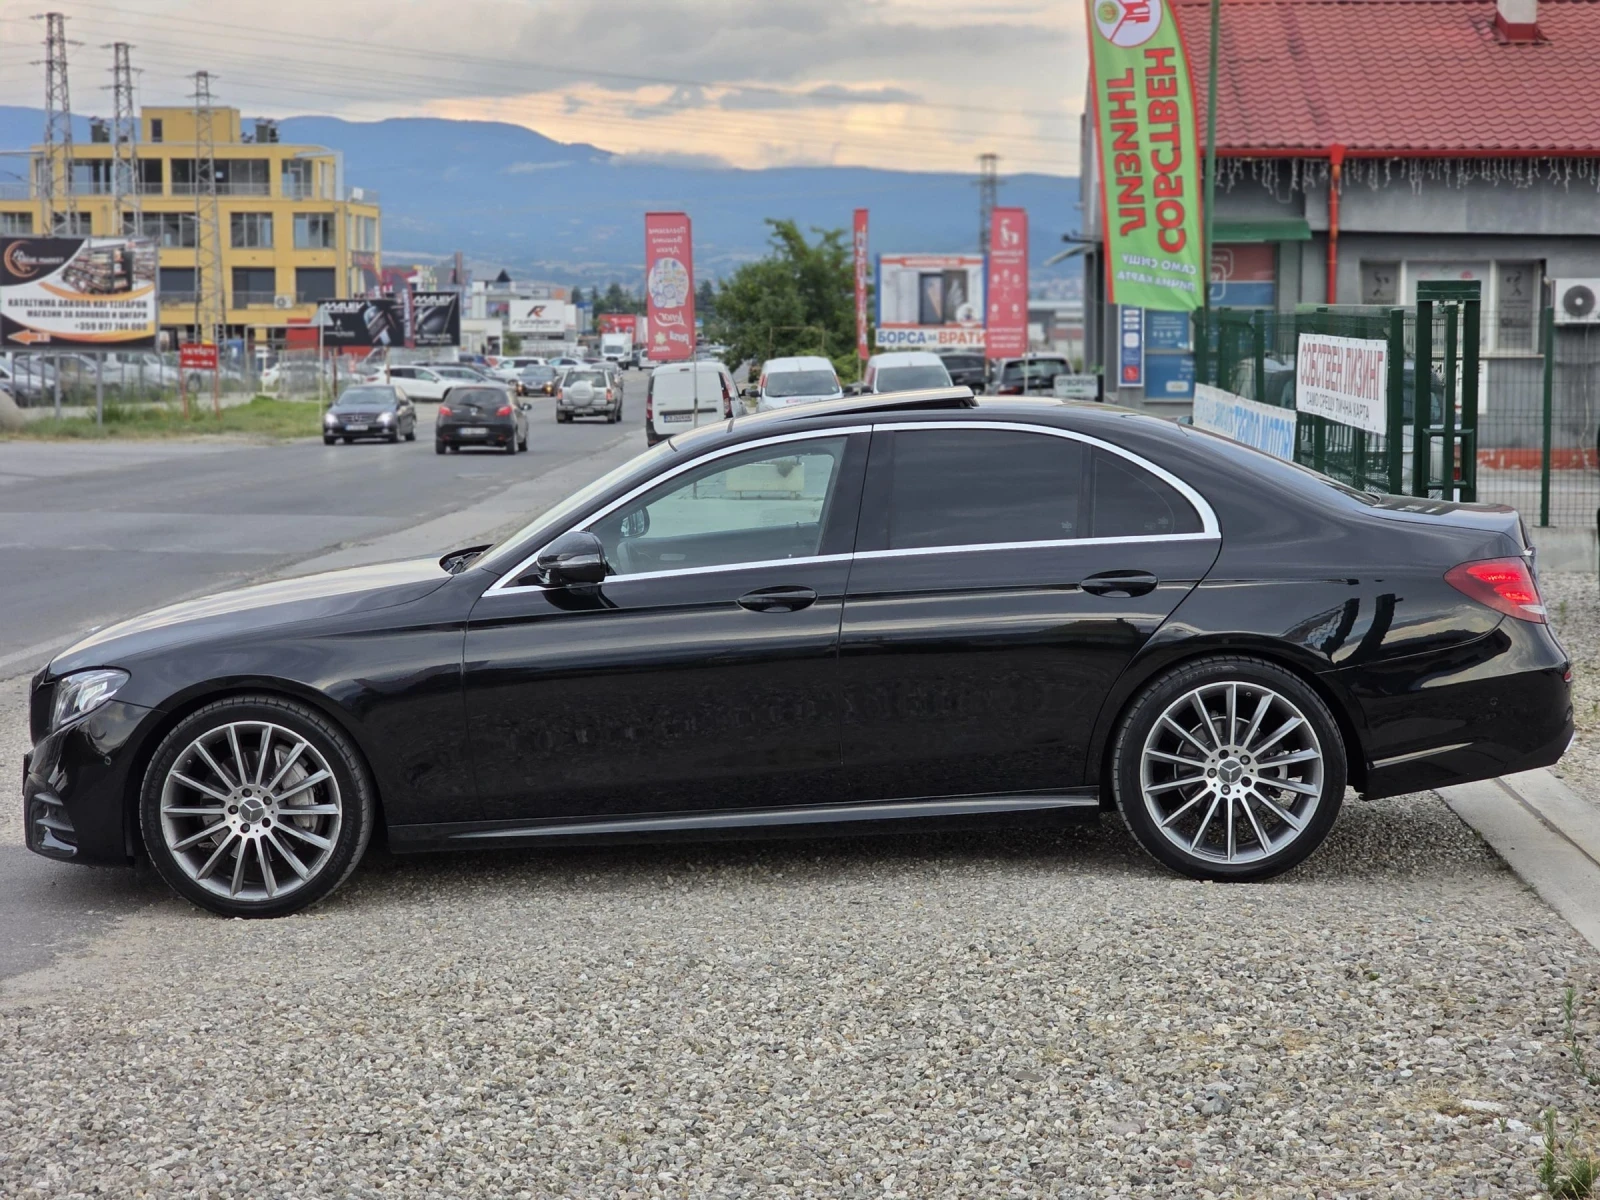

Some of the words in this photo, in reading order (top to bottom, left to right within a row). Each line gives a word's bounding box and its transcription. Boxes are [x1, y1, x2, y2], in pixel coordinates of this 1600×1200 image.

[877, 331, 926, 344] БОРСА
[1301, 342, 1343, 393] СОБСТВЕН
[1344, 347, 1383, 401] ЛИЗИНГ
[1353, 402, 1369, 422] КАРТА
